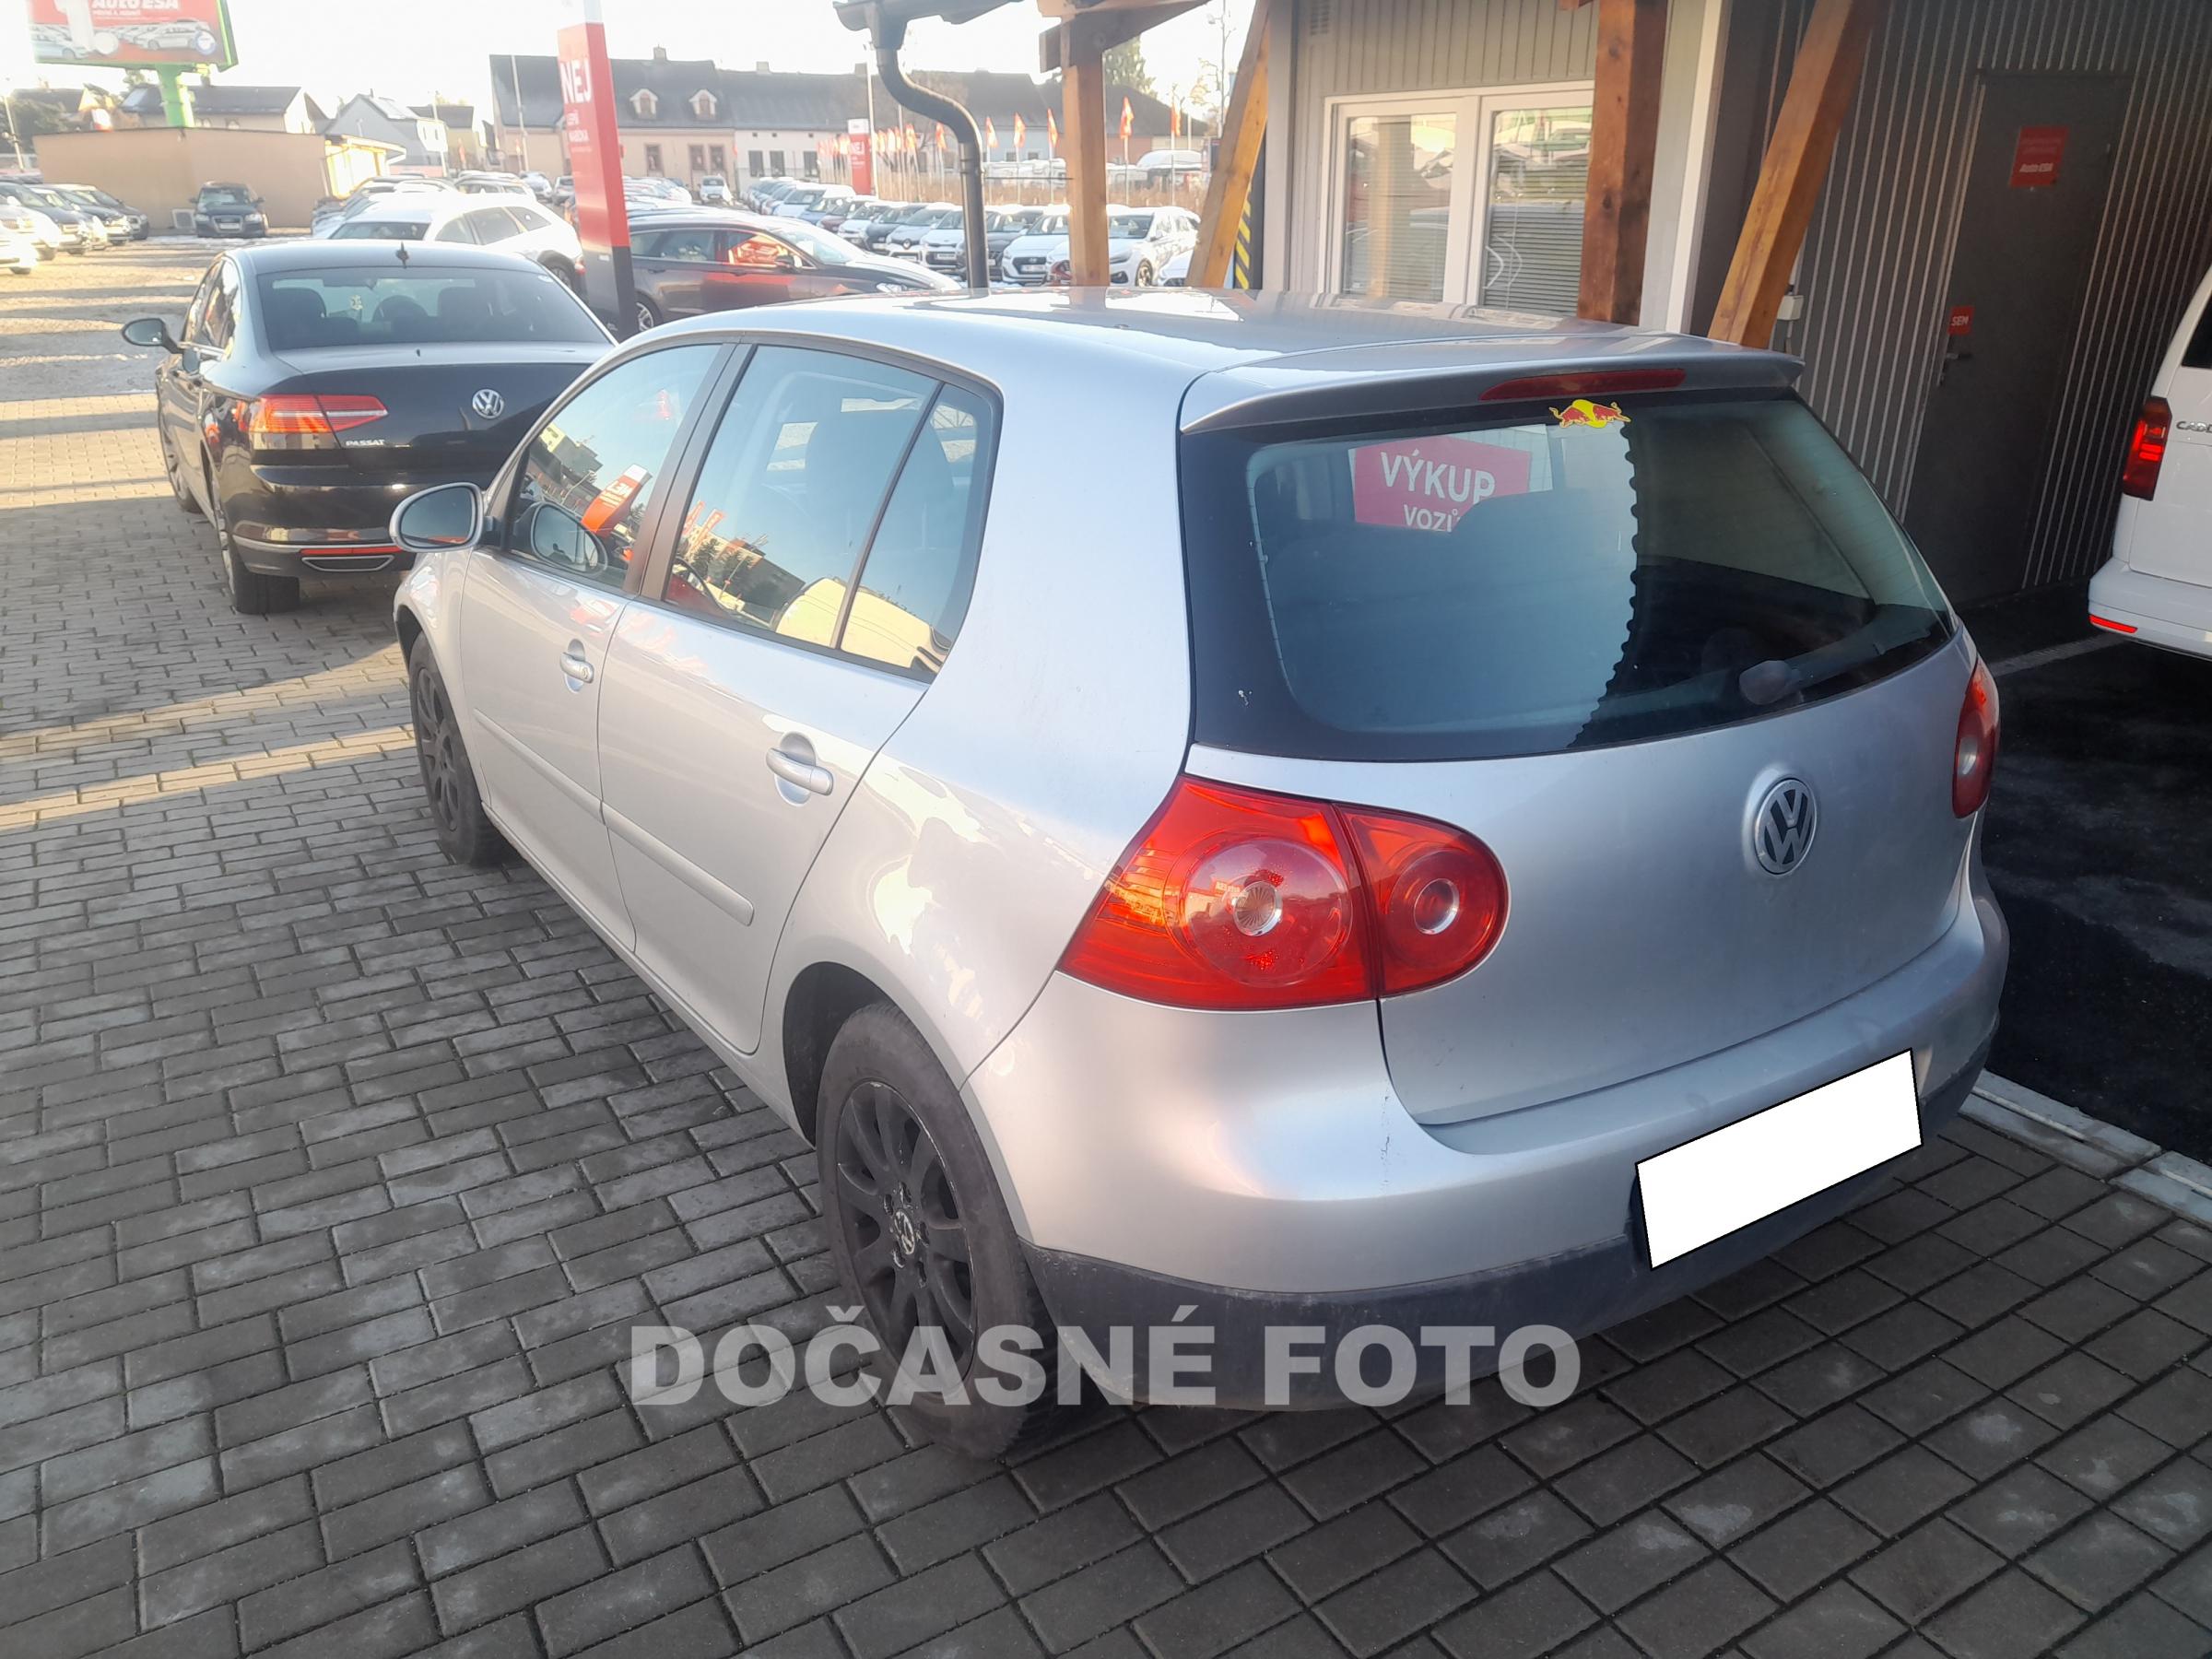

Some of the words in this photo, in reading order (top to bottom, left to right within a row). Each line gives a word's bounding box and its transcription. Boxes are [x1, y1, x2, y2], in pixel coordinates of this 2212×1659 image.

[560, 59, 592, 104] NEJ
[1950, 315, 1969, 325] SEM
[1381, 448, 1496, 505] VÝKUP
